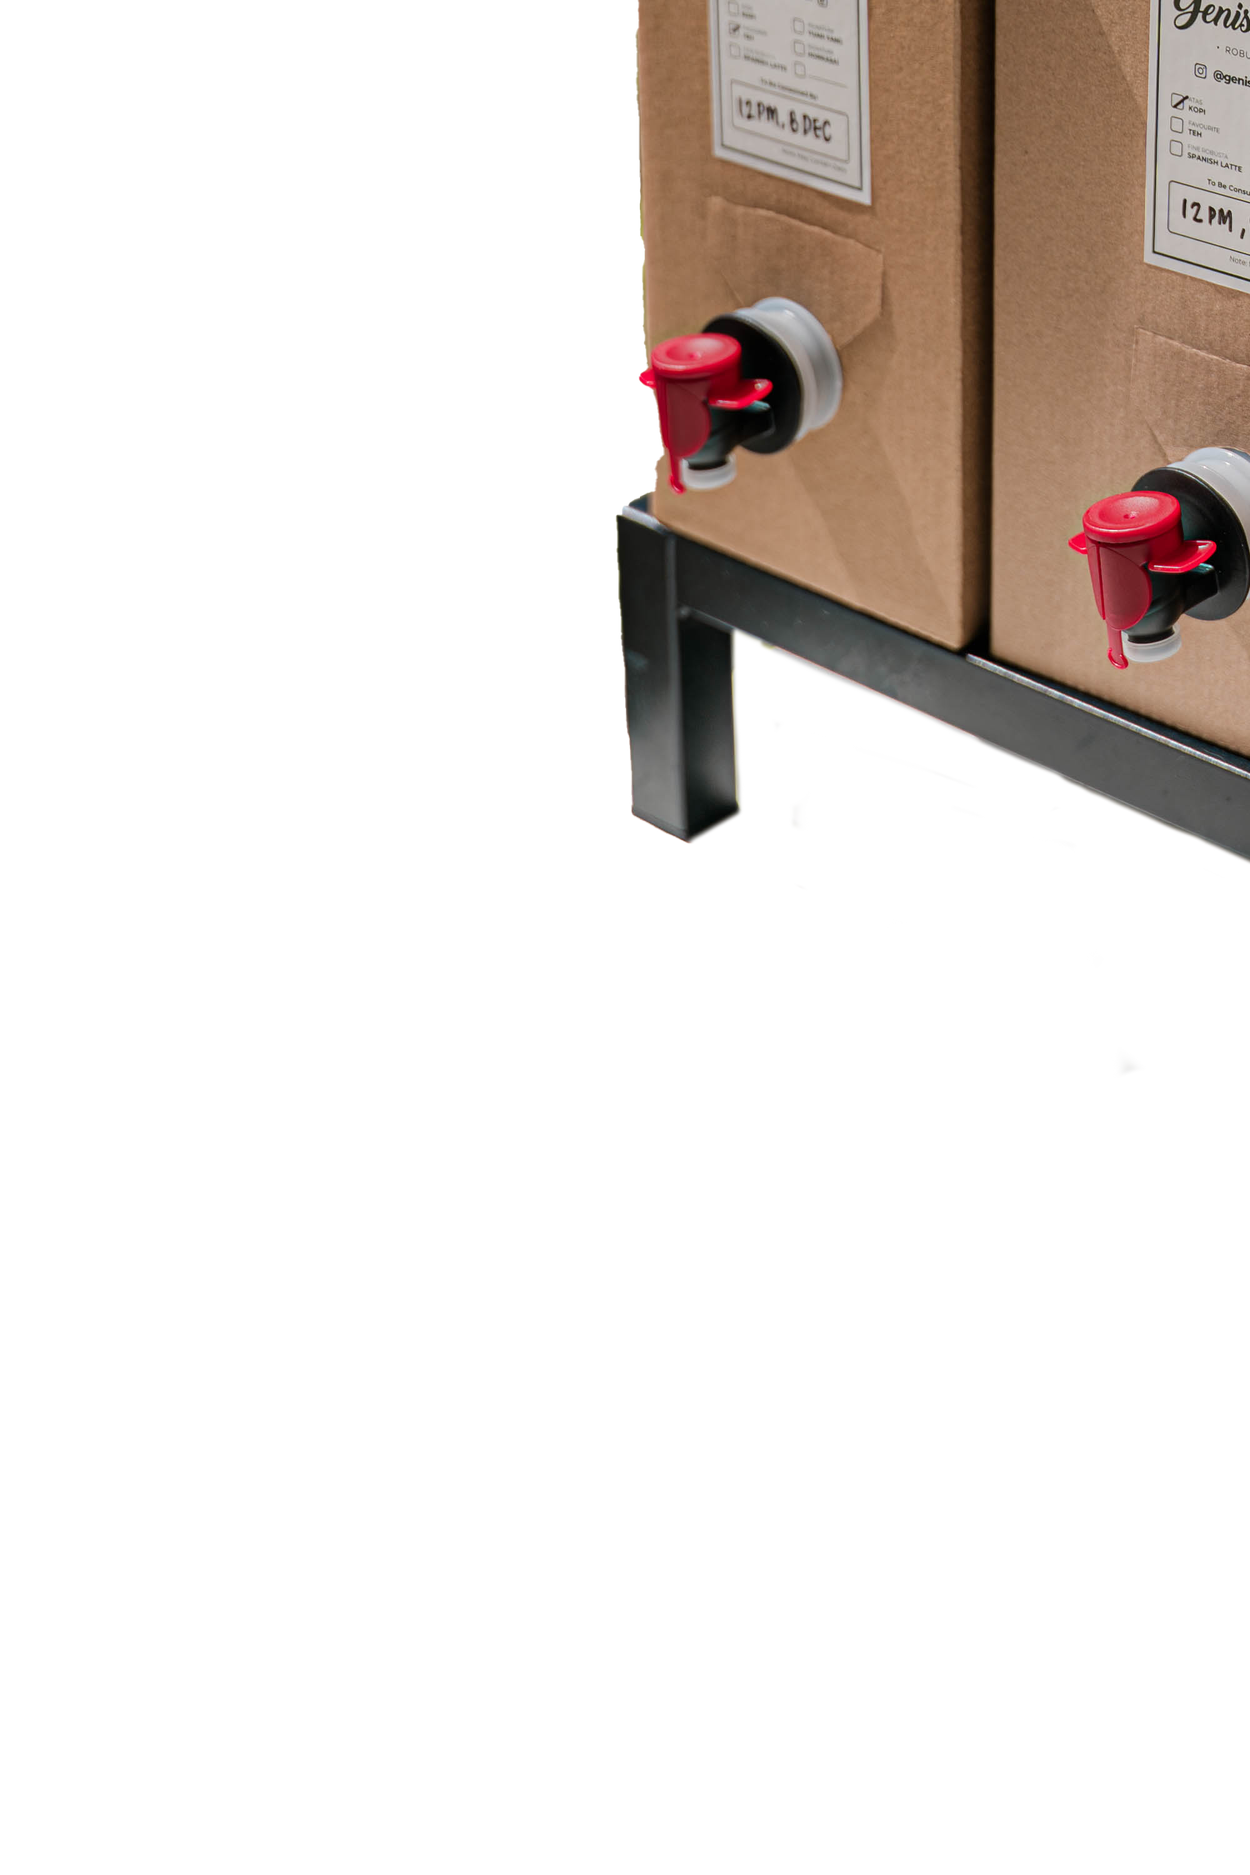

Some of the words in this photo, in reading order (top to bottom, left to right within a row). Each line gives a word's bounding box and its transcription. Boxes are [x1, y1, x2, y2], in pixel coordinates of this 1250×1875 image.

[1188, 105, 1206, 115] KOPI
[802, 113, 832, 142] DEC
[1188, 120, 1220, 134] FAVOURITE
[1188, 128, 1203, 138] TEH
[1187, 151, 1219, 166] SPANISH
[1220, 161, 1243, 173] LATTE
[1207, 178, 1216, 186] To
[1217, 181, 1227, 189] Be
[1229, 255, 1248, 267] Note:
